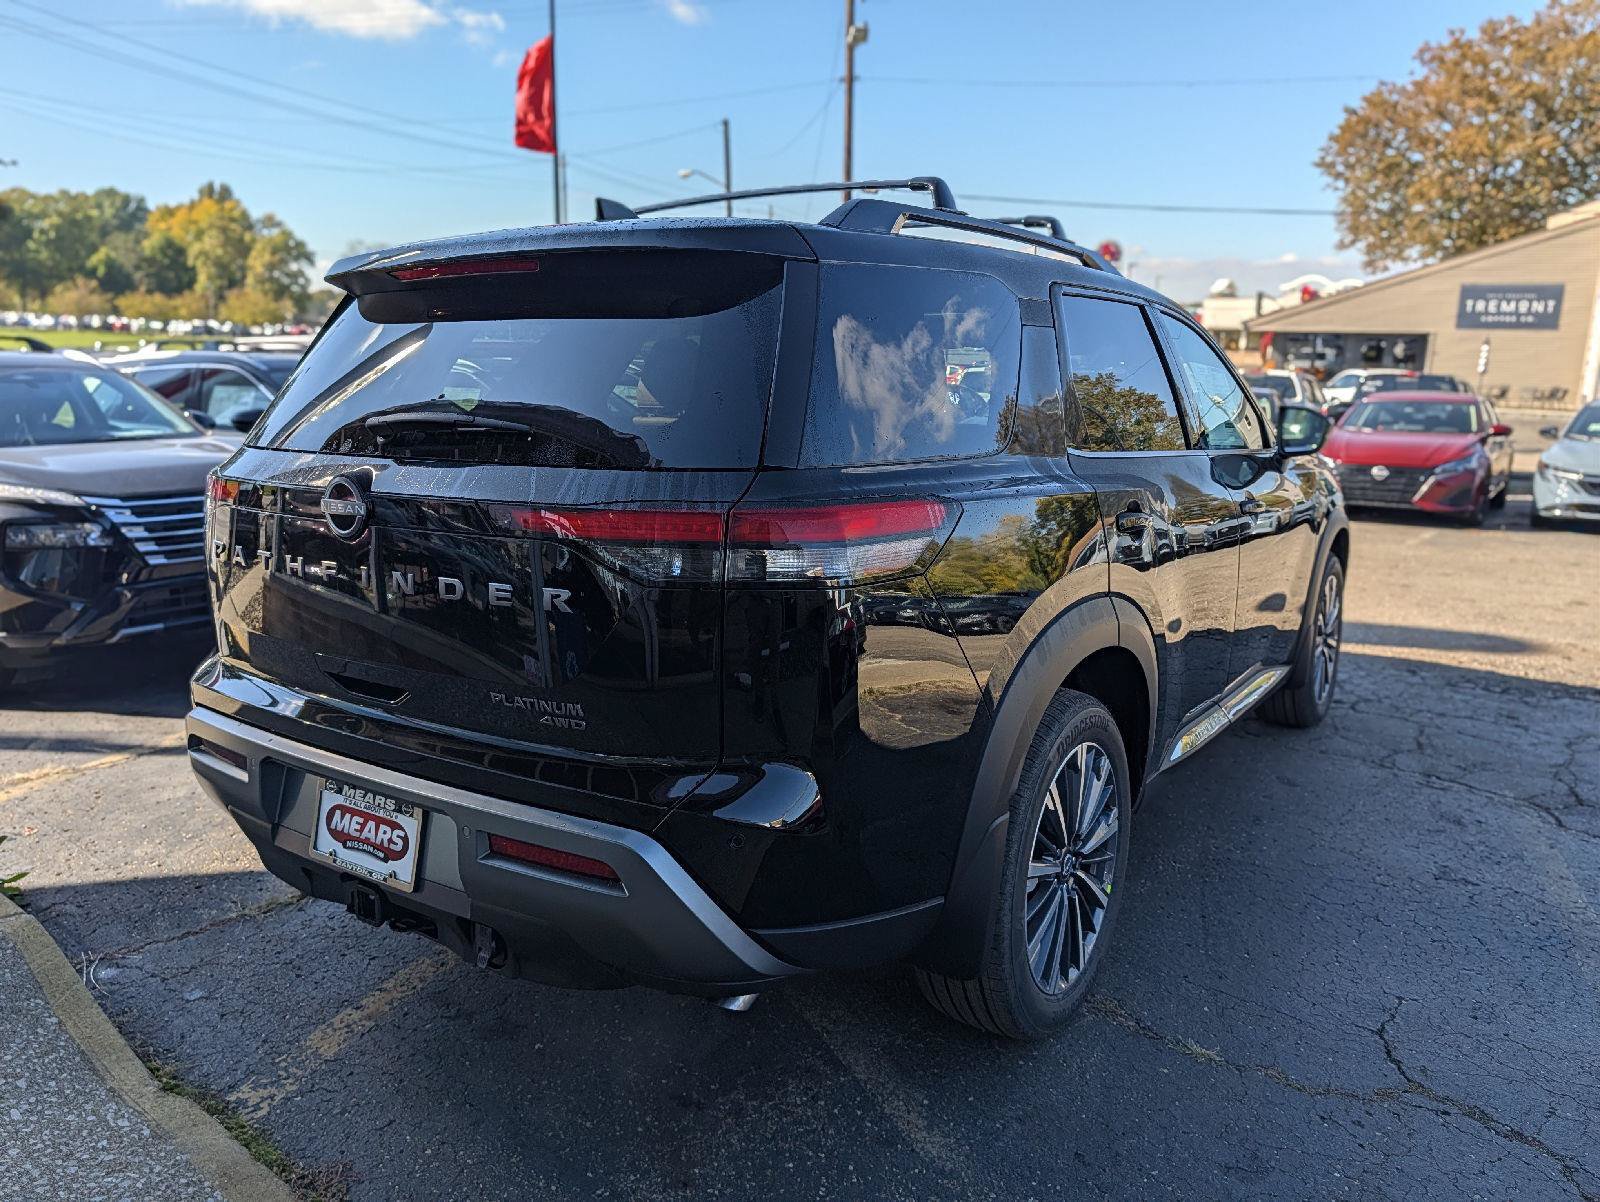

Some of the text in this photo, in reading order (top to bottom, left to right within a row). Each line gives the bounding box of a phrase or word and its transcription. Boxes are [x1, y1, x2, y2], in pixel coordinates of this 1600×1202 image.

[1465, 299, 1556, 314] TREMONT
[321, 500, 365, 515] NISSAN
[213, 540, 573, 613] PATHFINDER
[489, 691, 584, 717] PLATINUM
[540, 716, 586, 731] 4WD
[341, 784, 396, 811] MEARS
[363, 803, 381, 815] ABOUT
[382, 808, 395, 819] YOU
[331, 809, 406, 852] MEARS
